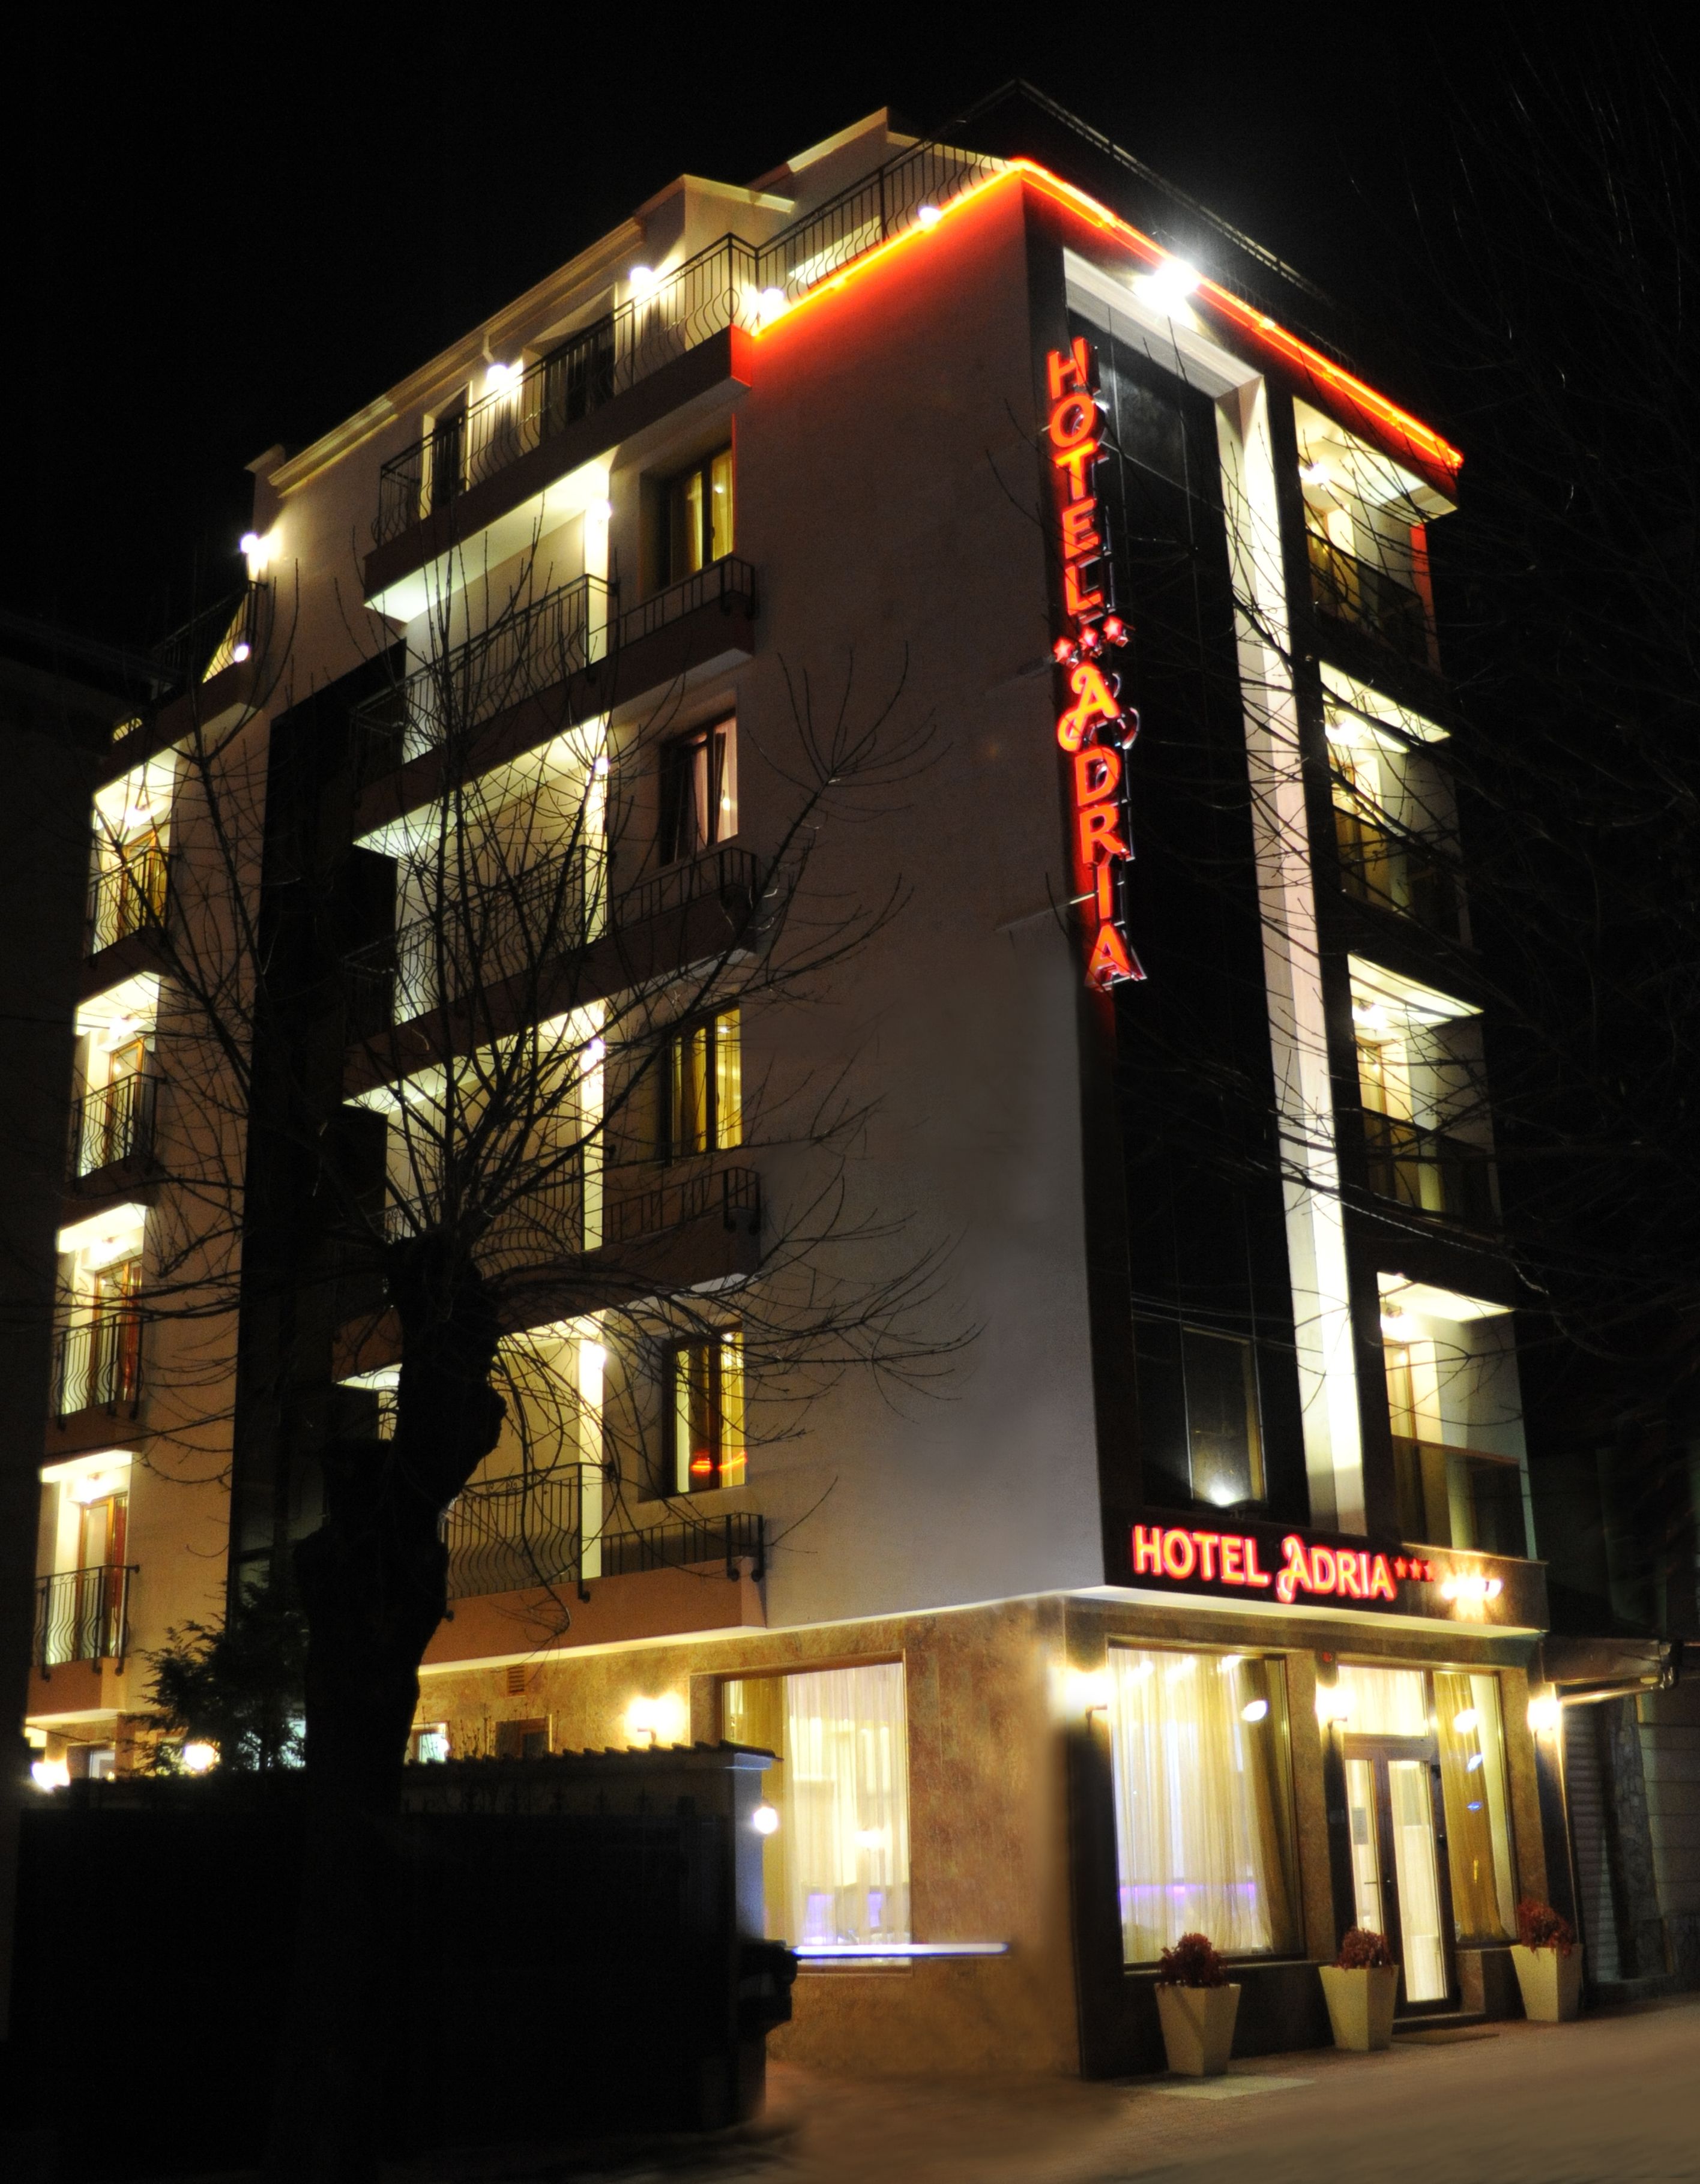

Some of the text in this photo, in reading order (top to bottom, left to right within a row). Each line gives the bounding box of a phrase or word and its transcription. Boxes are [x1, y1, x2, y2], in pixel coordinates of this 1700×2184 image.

[1047, 336, 1133, 987] HOTEL ADRIA
[1133, 1524, 1396, 1604] HOTEL ADRIA
